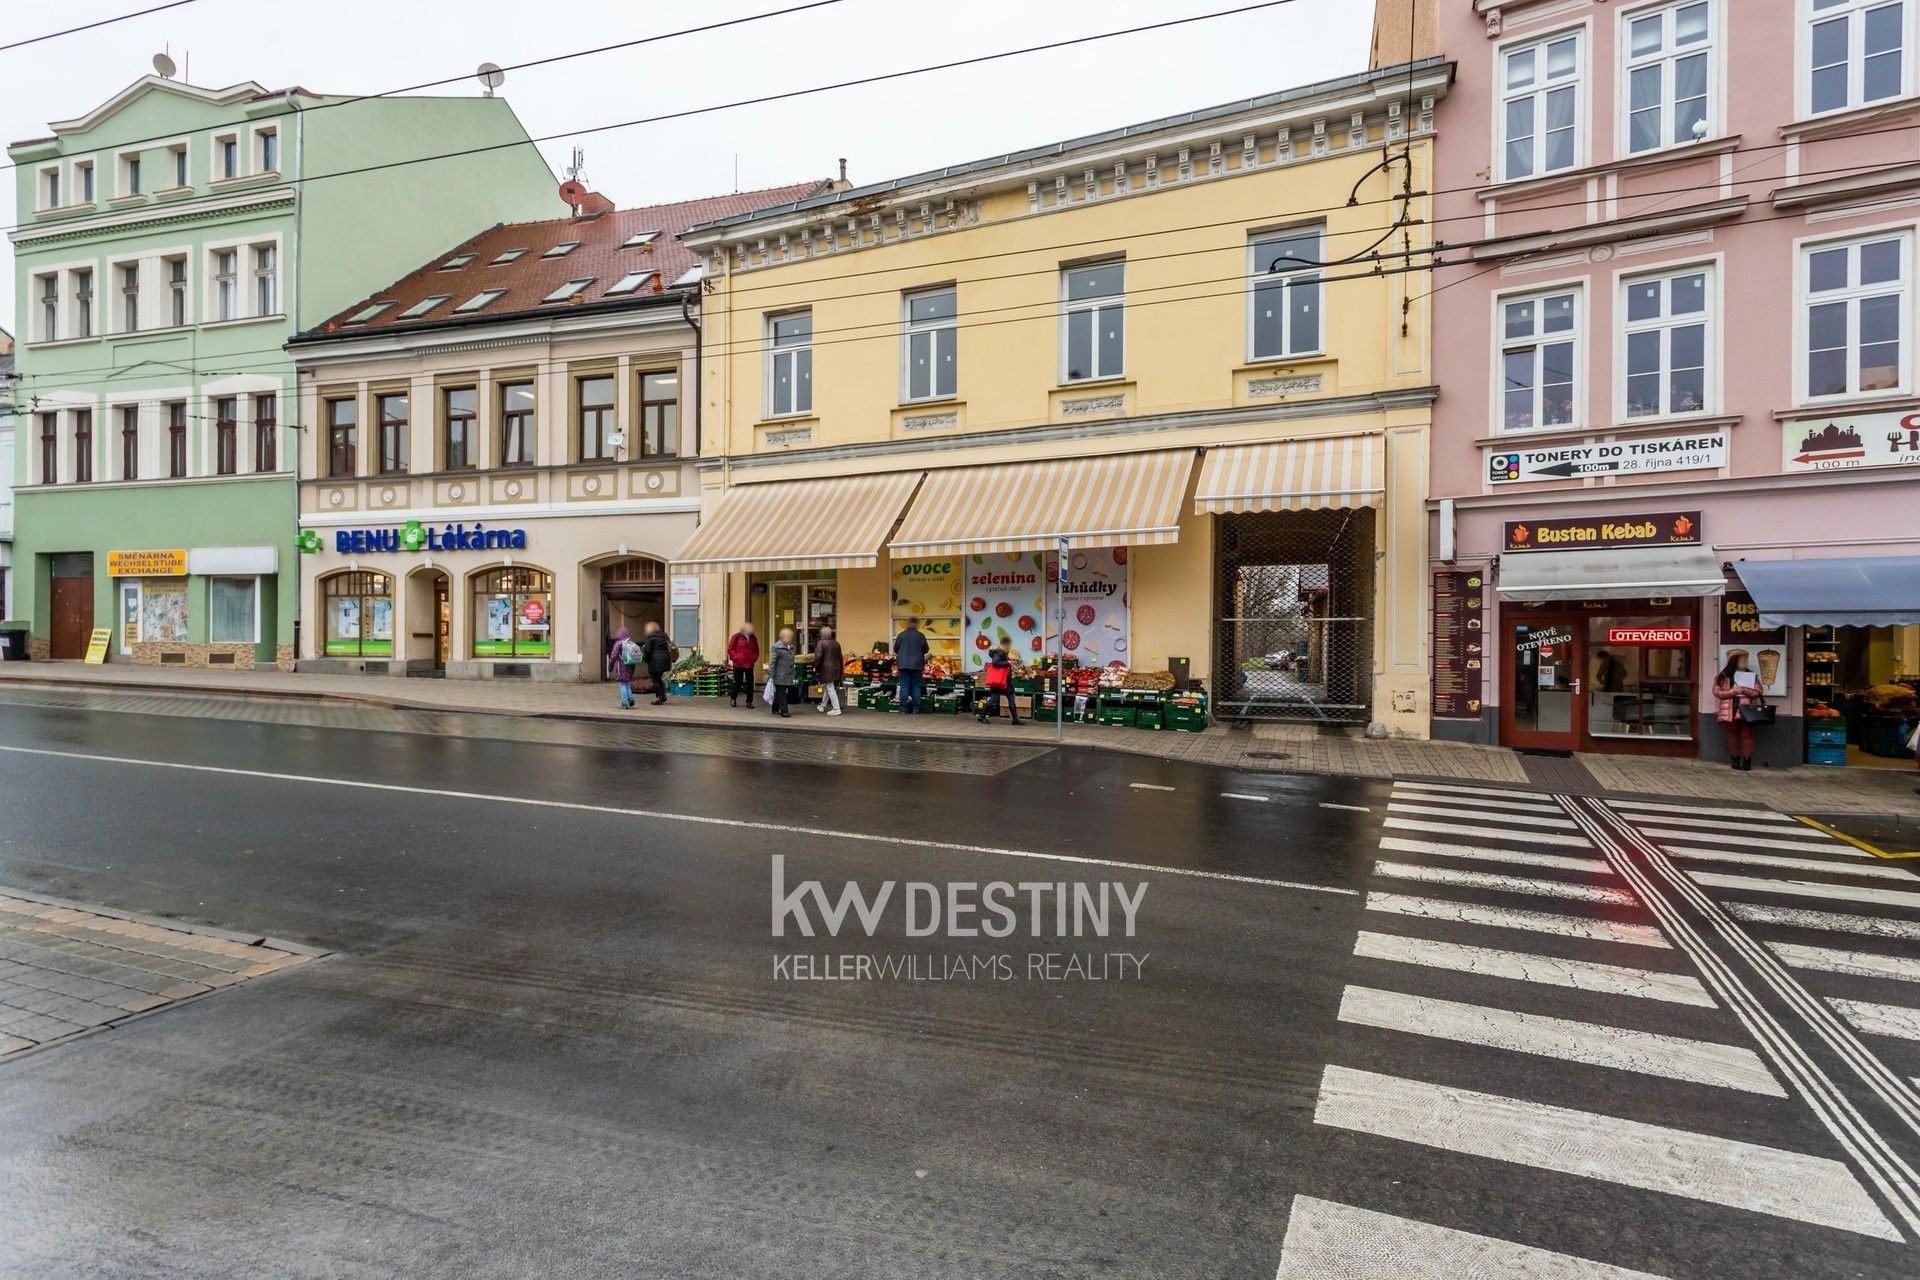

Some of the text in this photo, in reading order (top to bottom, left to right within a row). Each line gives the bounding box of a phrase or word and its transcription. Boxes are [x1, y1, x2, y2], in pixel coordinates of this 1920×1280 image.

[1525, 436, 1723, 463] TONERY DO TISKÁREN
[1578, 463, 1610, 472] 100m
[1623, 454, 1711, 470] 28. října 419/1
[1814, 461, 1841, 469] 100
[336, 522, 526, 554] BENU Lékárna
[1537, 521, 1657, 543] Bustan Kebab
[110, 559, 184, 567] WECHSELSTUBE
[118, 566, 173, 574] EXCHANGE
[902, 562, 952, 576] ovoce
[971, 571, 1036, 585] zelenina
[1055, 581, 1118, 596] lahůdky
[1726, 601, 1760, 615] Bus
[1730, 618, 1777, 632] Keb
[1615, 630, 1683, 641] OTEVŘENO
[1516, 634, 1572, 652] OTEVŘENO
